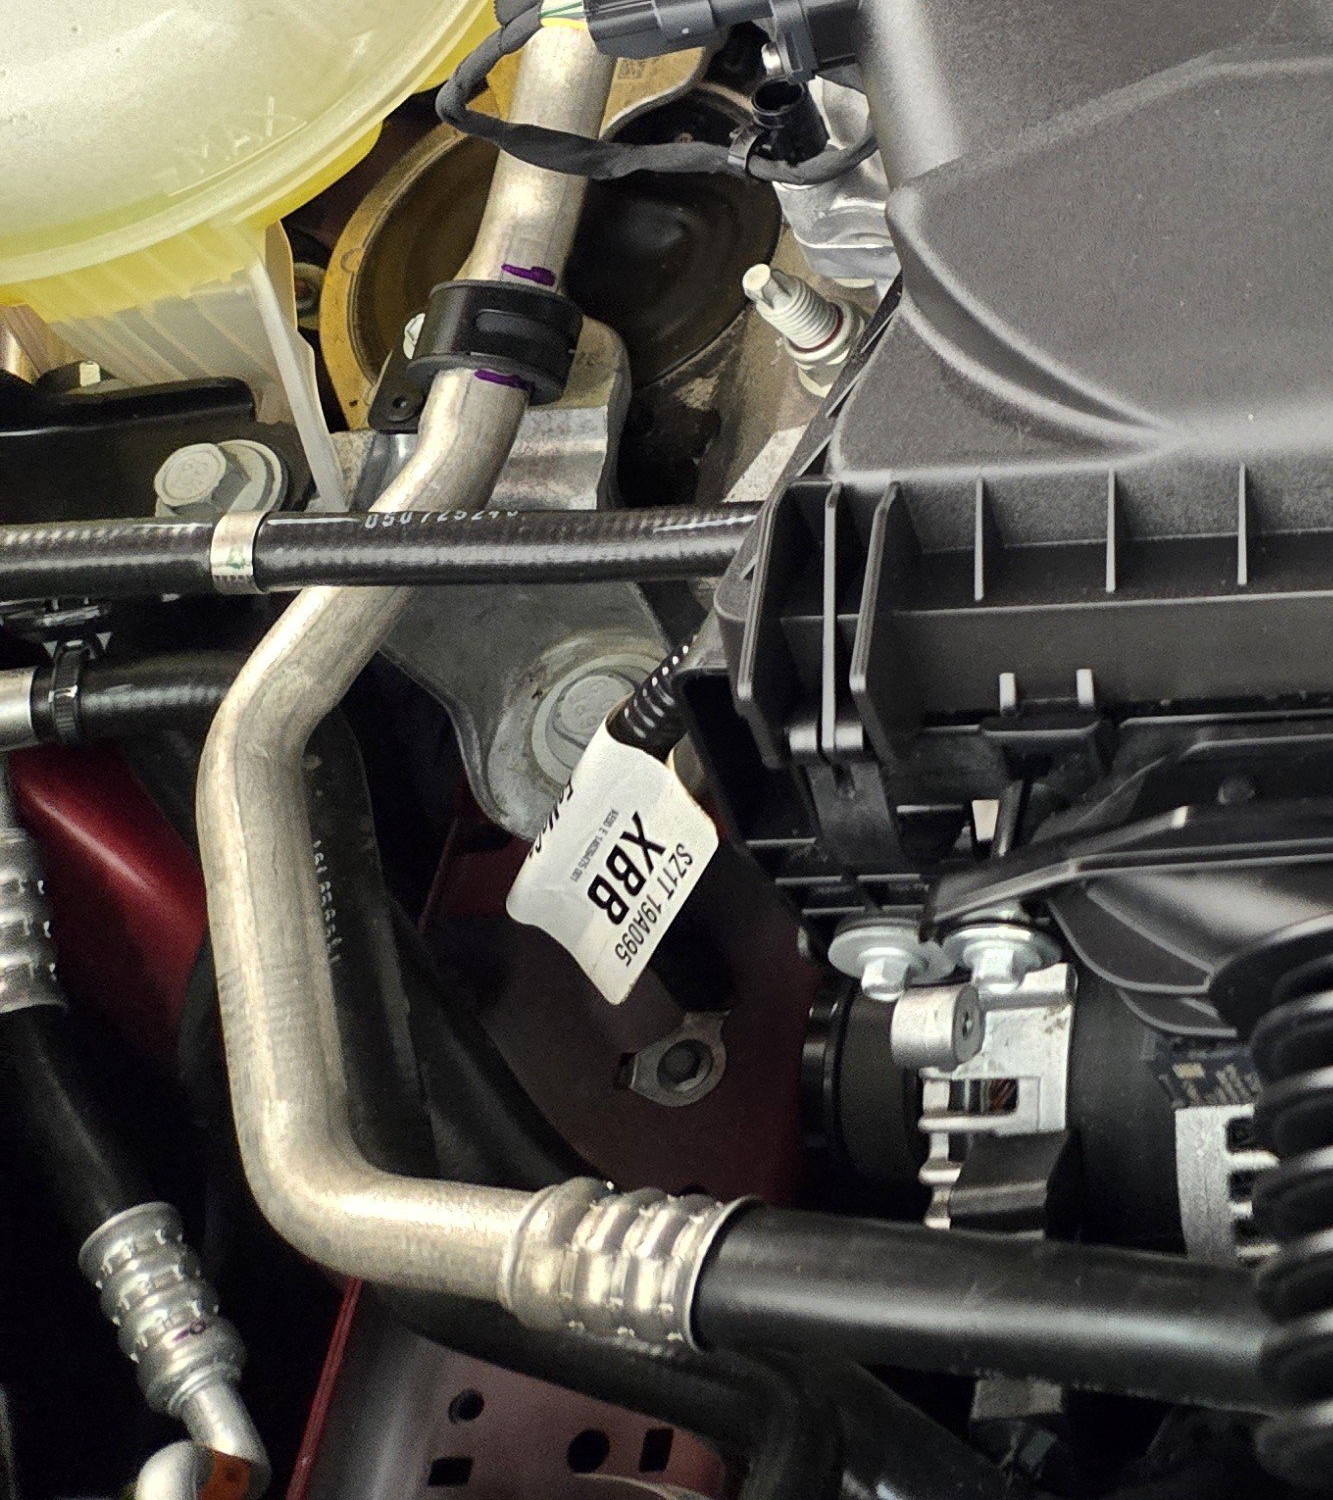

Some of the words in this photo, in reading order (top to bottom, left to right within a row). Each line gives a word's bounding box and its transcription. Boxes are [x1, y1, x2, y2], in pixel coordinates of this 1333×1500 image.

[586, 811, 667, 926] XBB
[656, 843, 694, 900] SZ1T
[614, 894, 663, 967] 19A095
